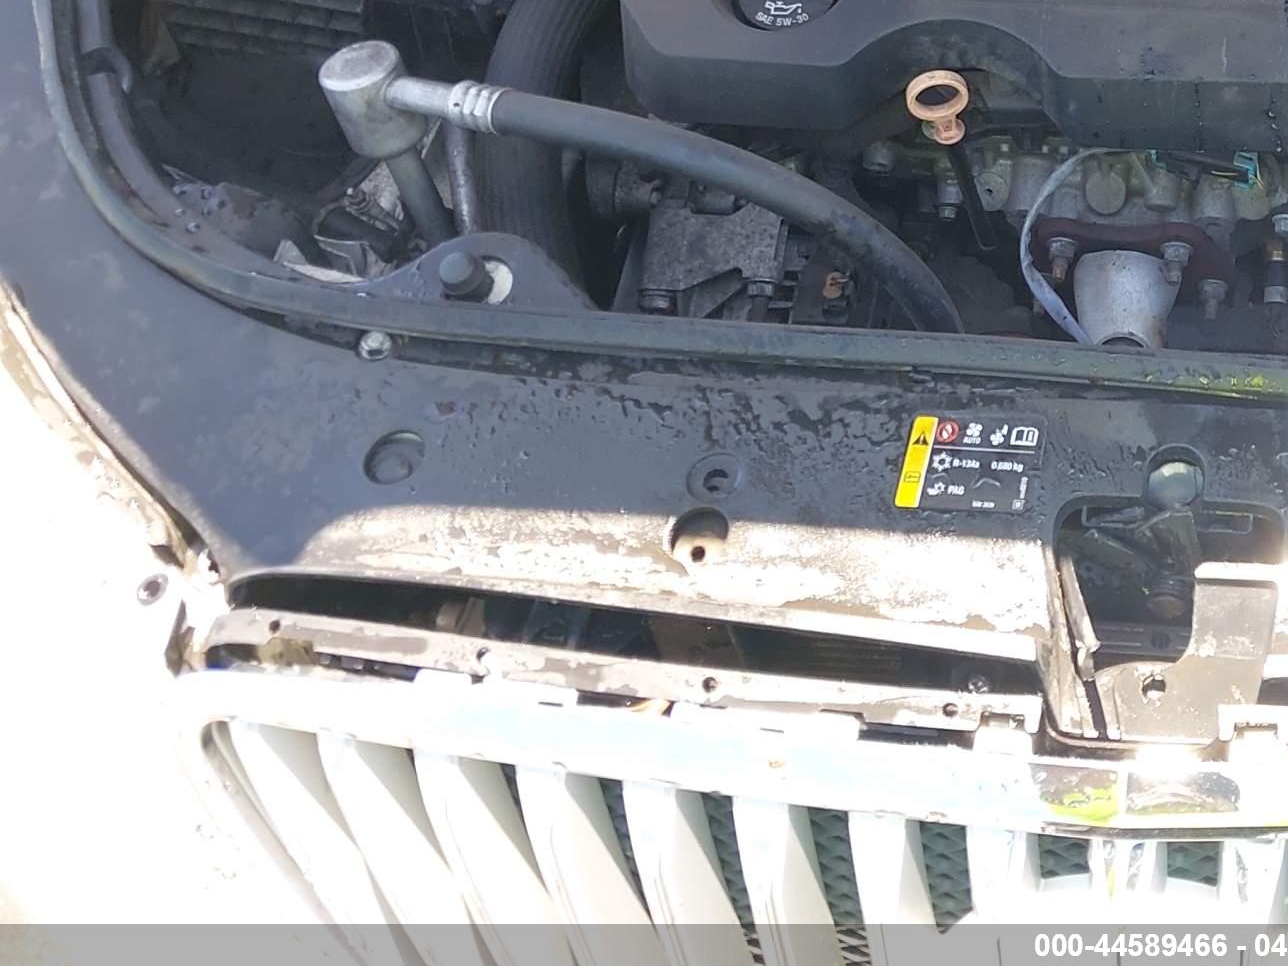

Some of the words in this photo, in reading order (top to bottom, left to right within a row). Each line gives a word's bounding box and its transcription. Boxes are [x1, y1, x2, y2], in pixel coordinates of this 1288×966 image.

[755, 12, 774, 25] SAE
[775, 13, 809, 27] 5W-30
[963, 436, 981, 445] AUTO
